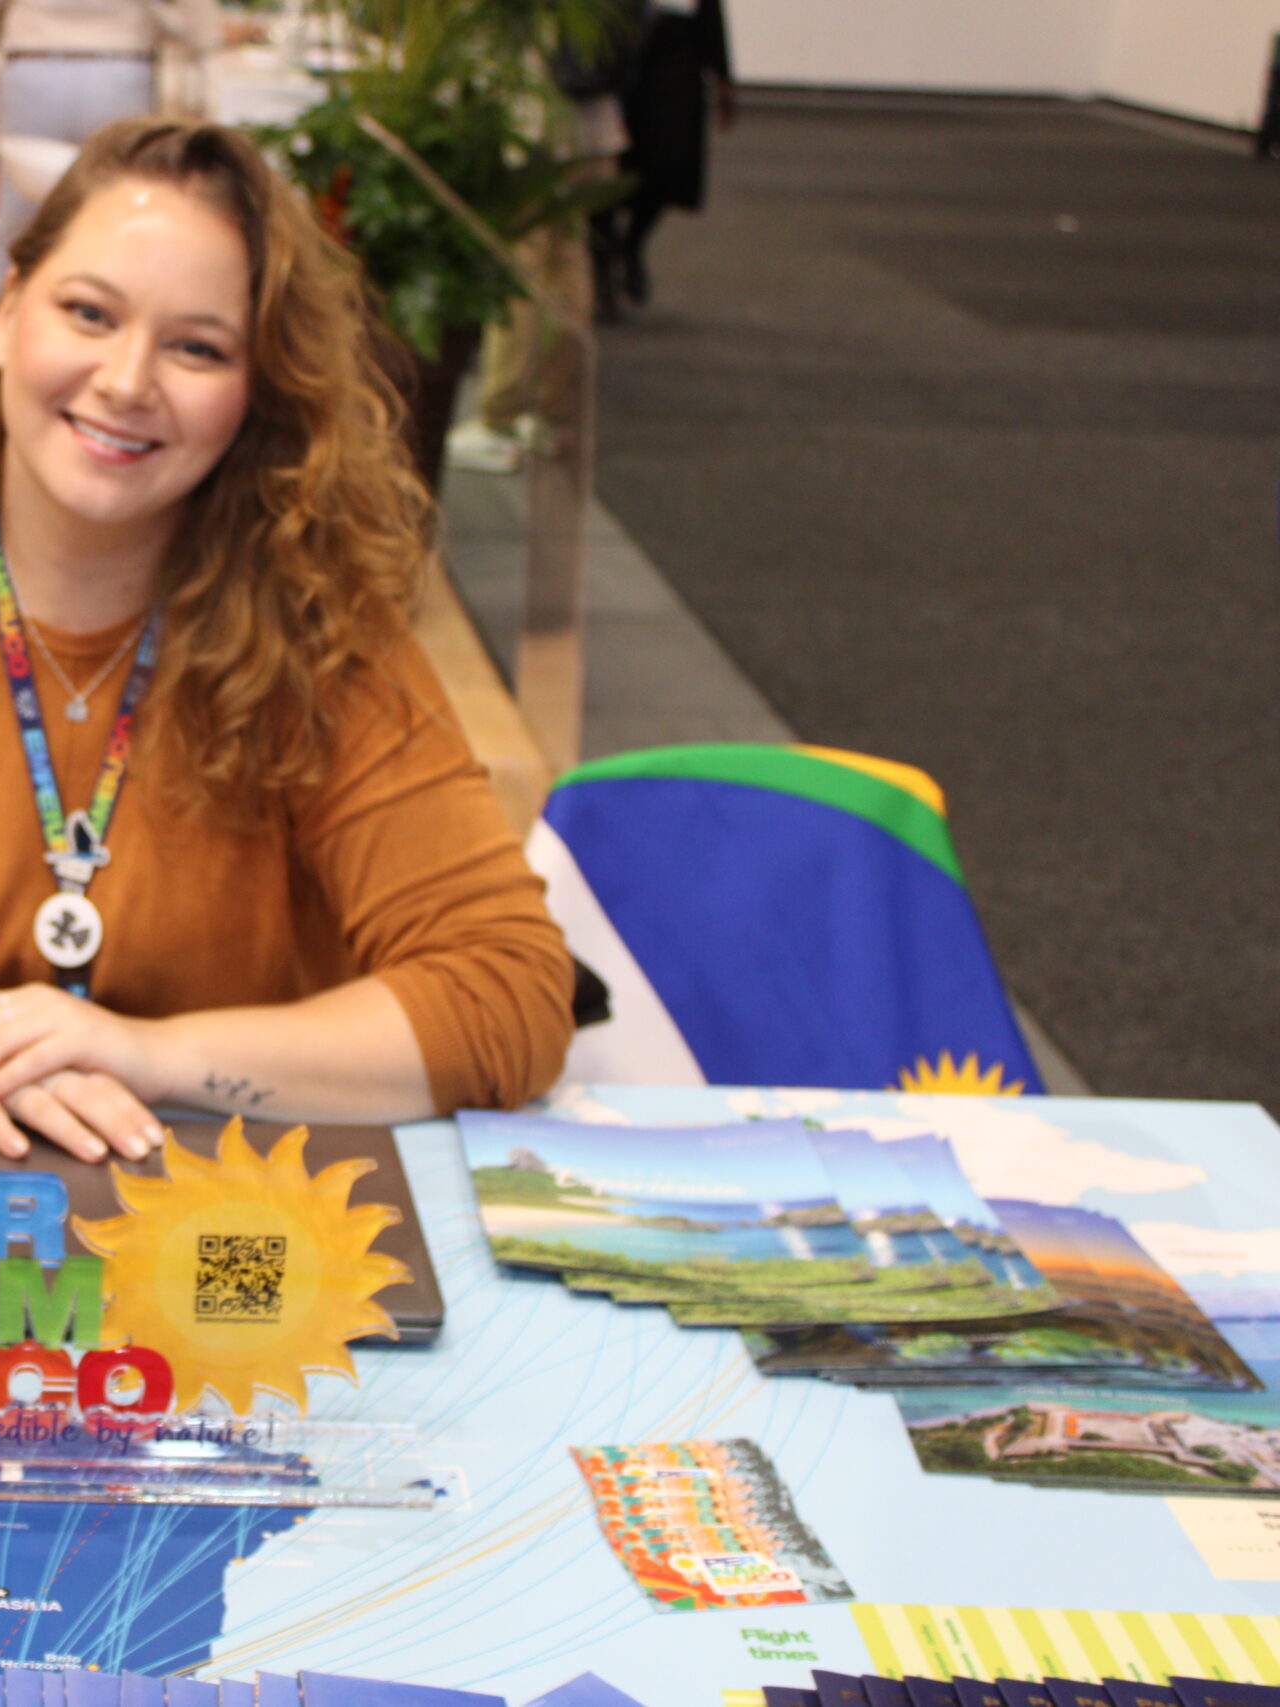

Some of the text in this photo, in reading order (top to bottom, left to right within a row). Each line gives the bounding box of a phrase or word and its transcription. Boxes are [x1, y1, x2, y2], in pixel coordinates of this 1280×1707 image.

[96, 1416, 134, 1455] by
[154, 1413, 275, 1449] nature!
[740, 1627, 813, 1645] Flight
[747, 1645, 820, 1662] times
